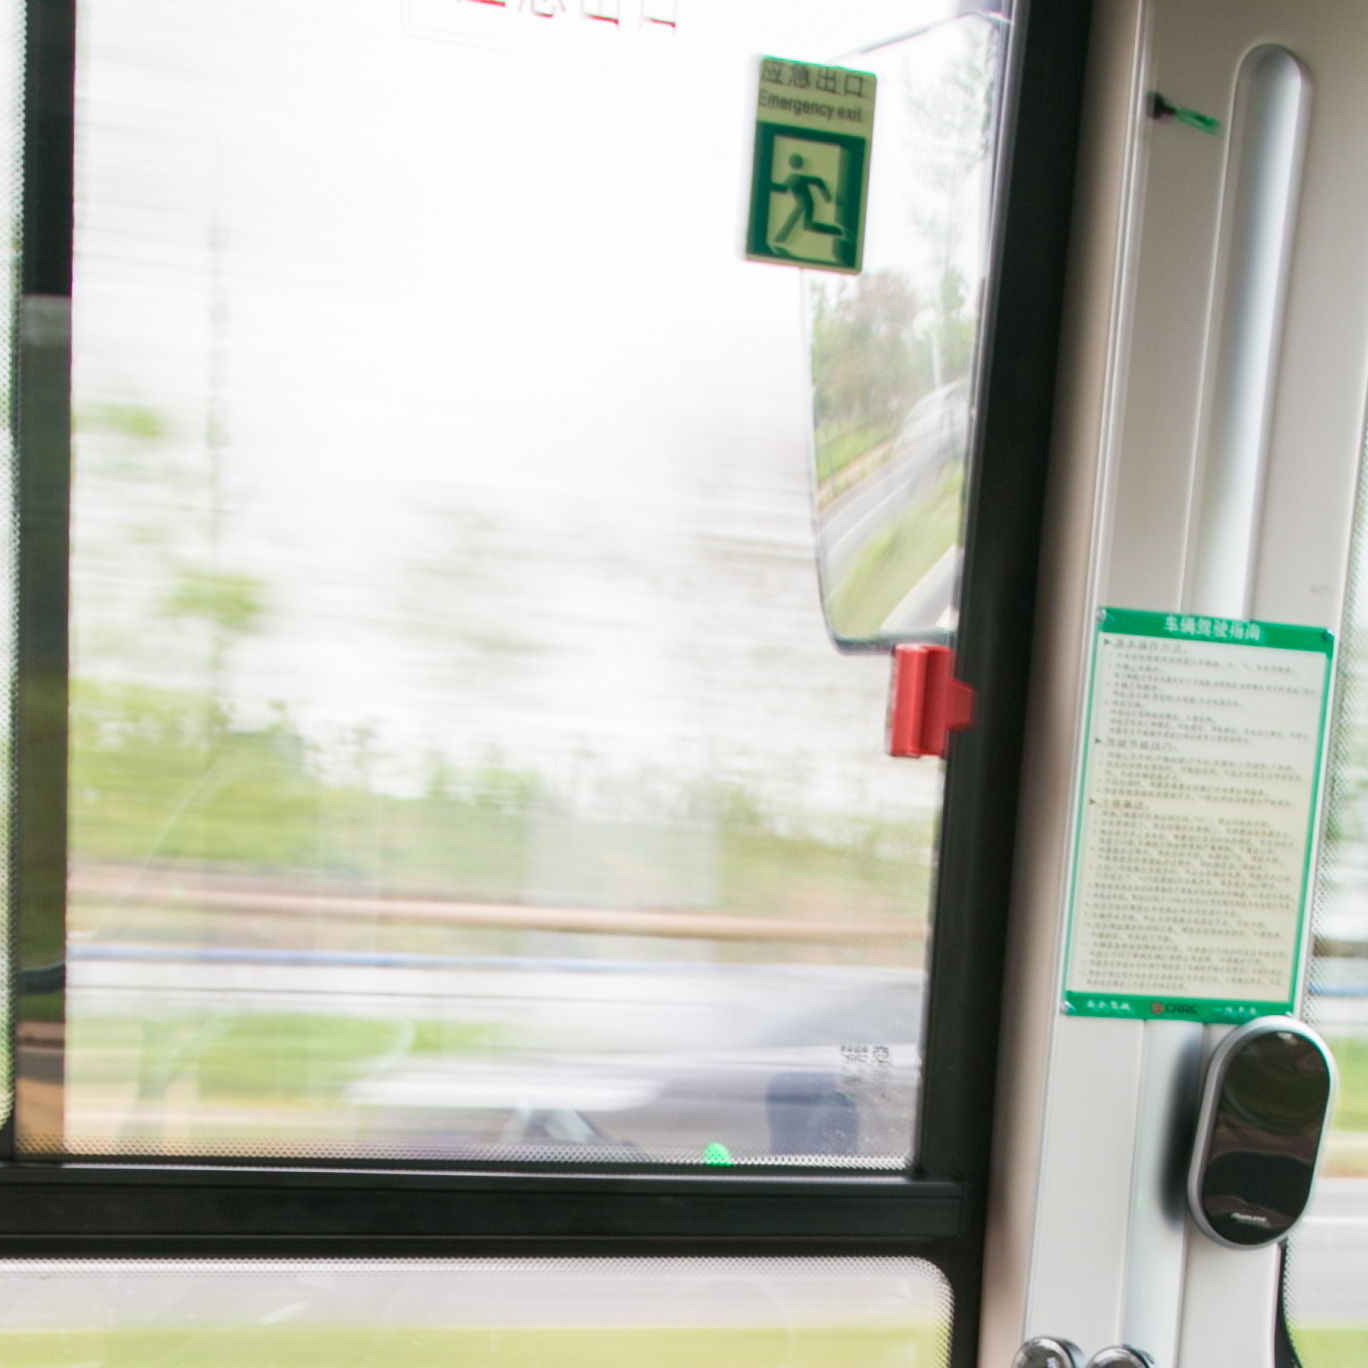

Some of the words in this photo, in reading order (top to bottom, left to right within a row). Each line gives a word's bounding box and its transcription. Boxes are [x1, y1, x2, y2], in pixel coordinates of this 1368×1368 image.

[762, 58, 863, 98] 应急出口
[759, 89, 834, 120] Emergency
[1164, 614, 1261, 641] 车辆驾驶指南
